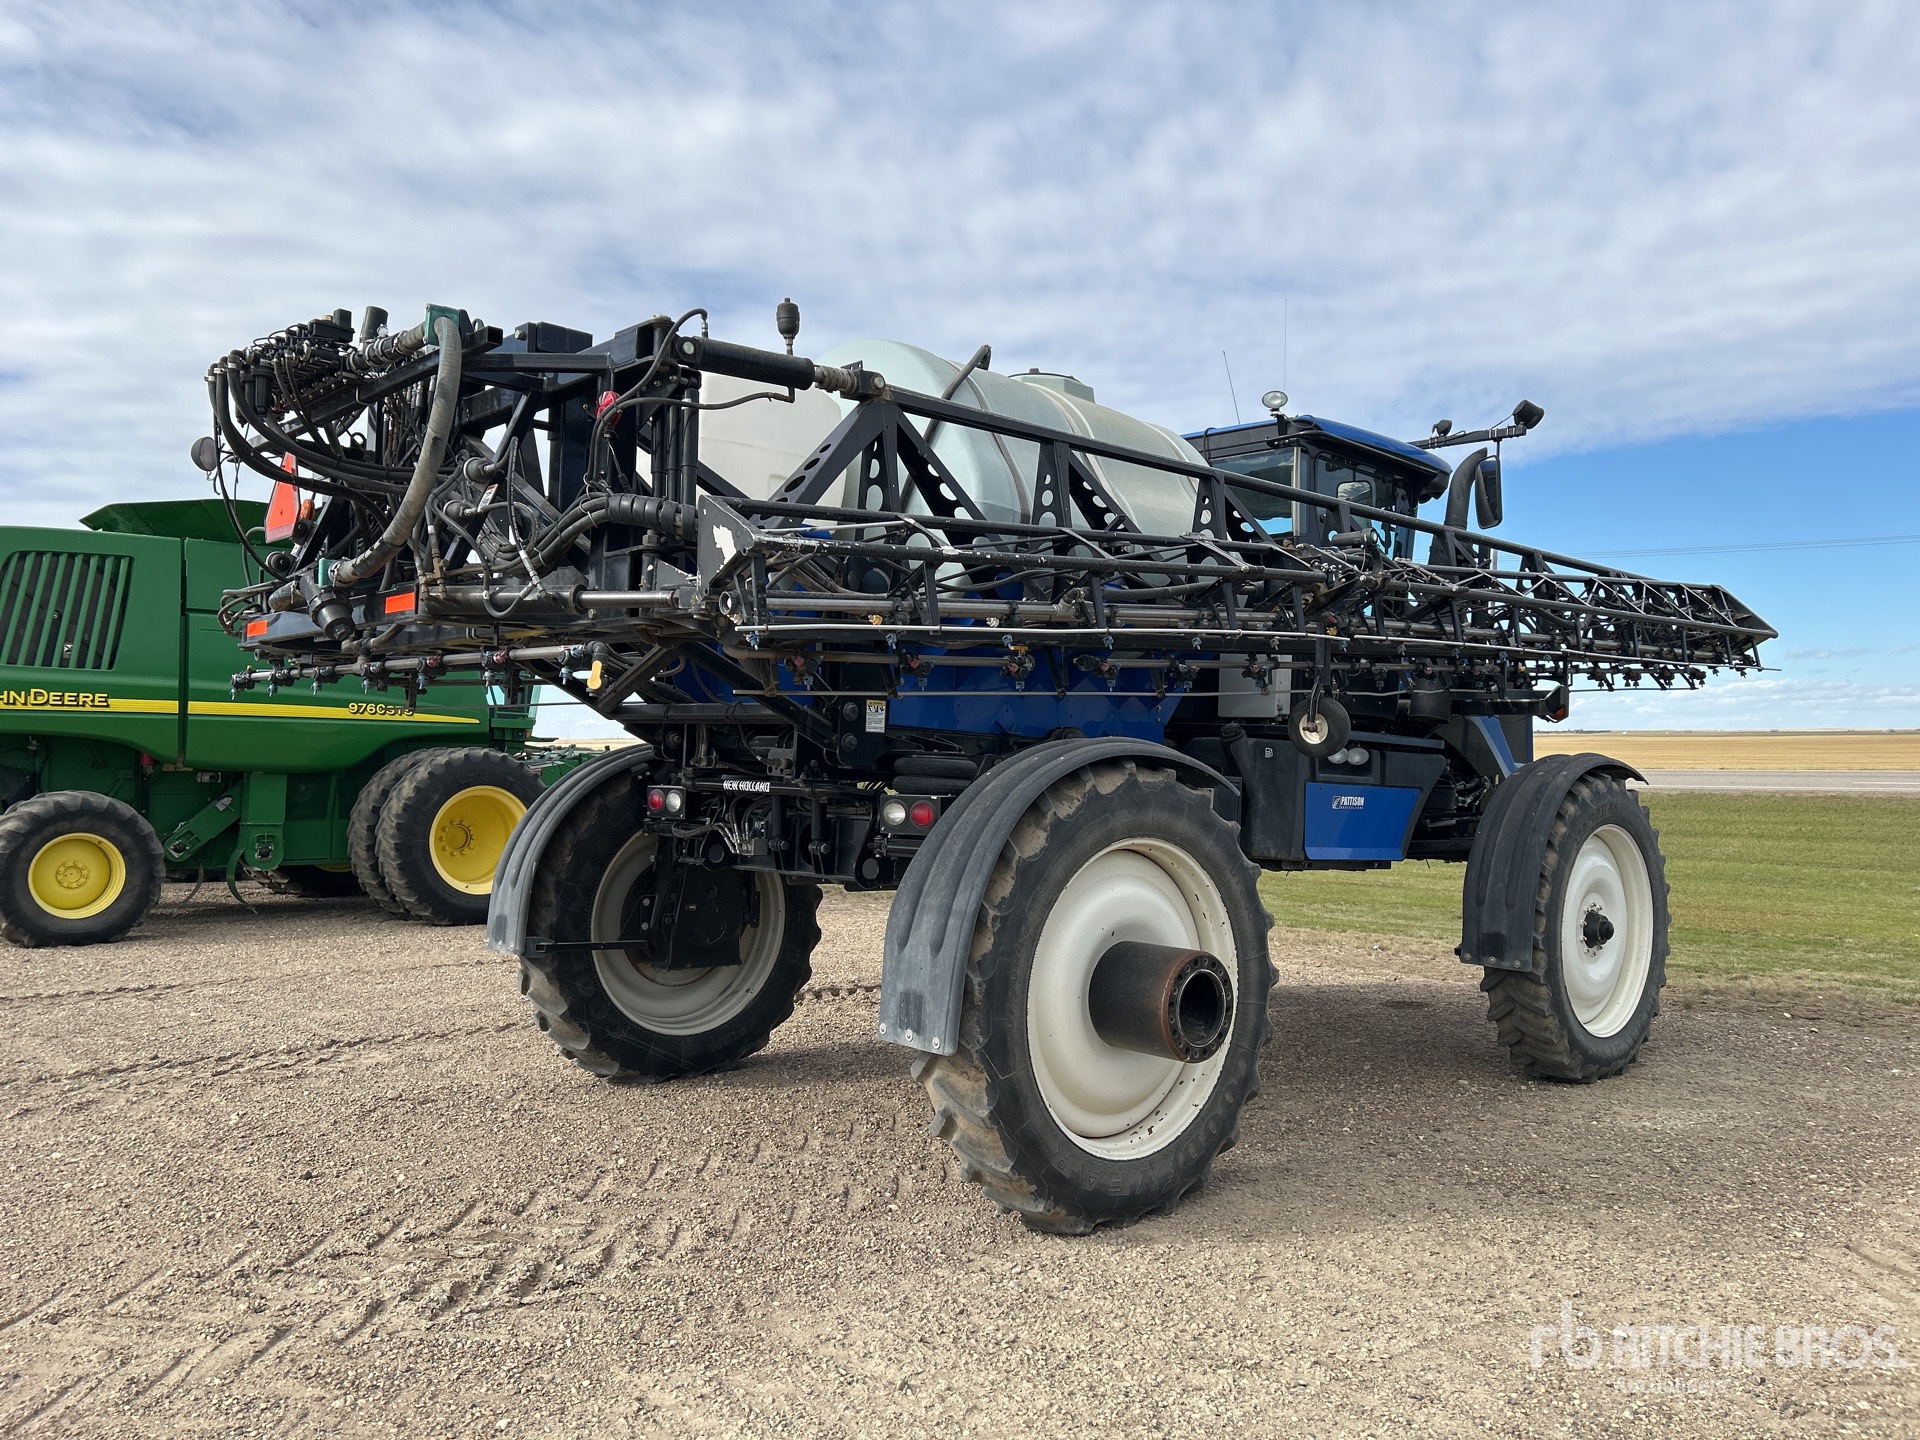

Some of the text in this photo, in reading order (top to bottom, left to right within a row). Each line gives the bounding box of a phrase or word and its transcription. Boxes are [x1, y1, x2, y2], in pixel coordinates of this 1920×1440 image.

[30, 688, 108, 706] DEERE
[723, 780, 770, 792] NEW HOLLAND
[1340, 796, 1365, 806] PATTISON
[1050, 1053, 1248, 1197] GOODYEAR
